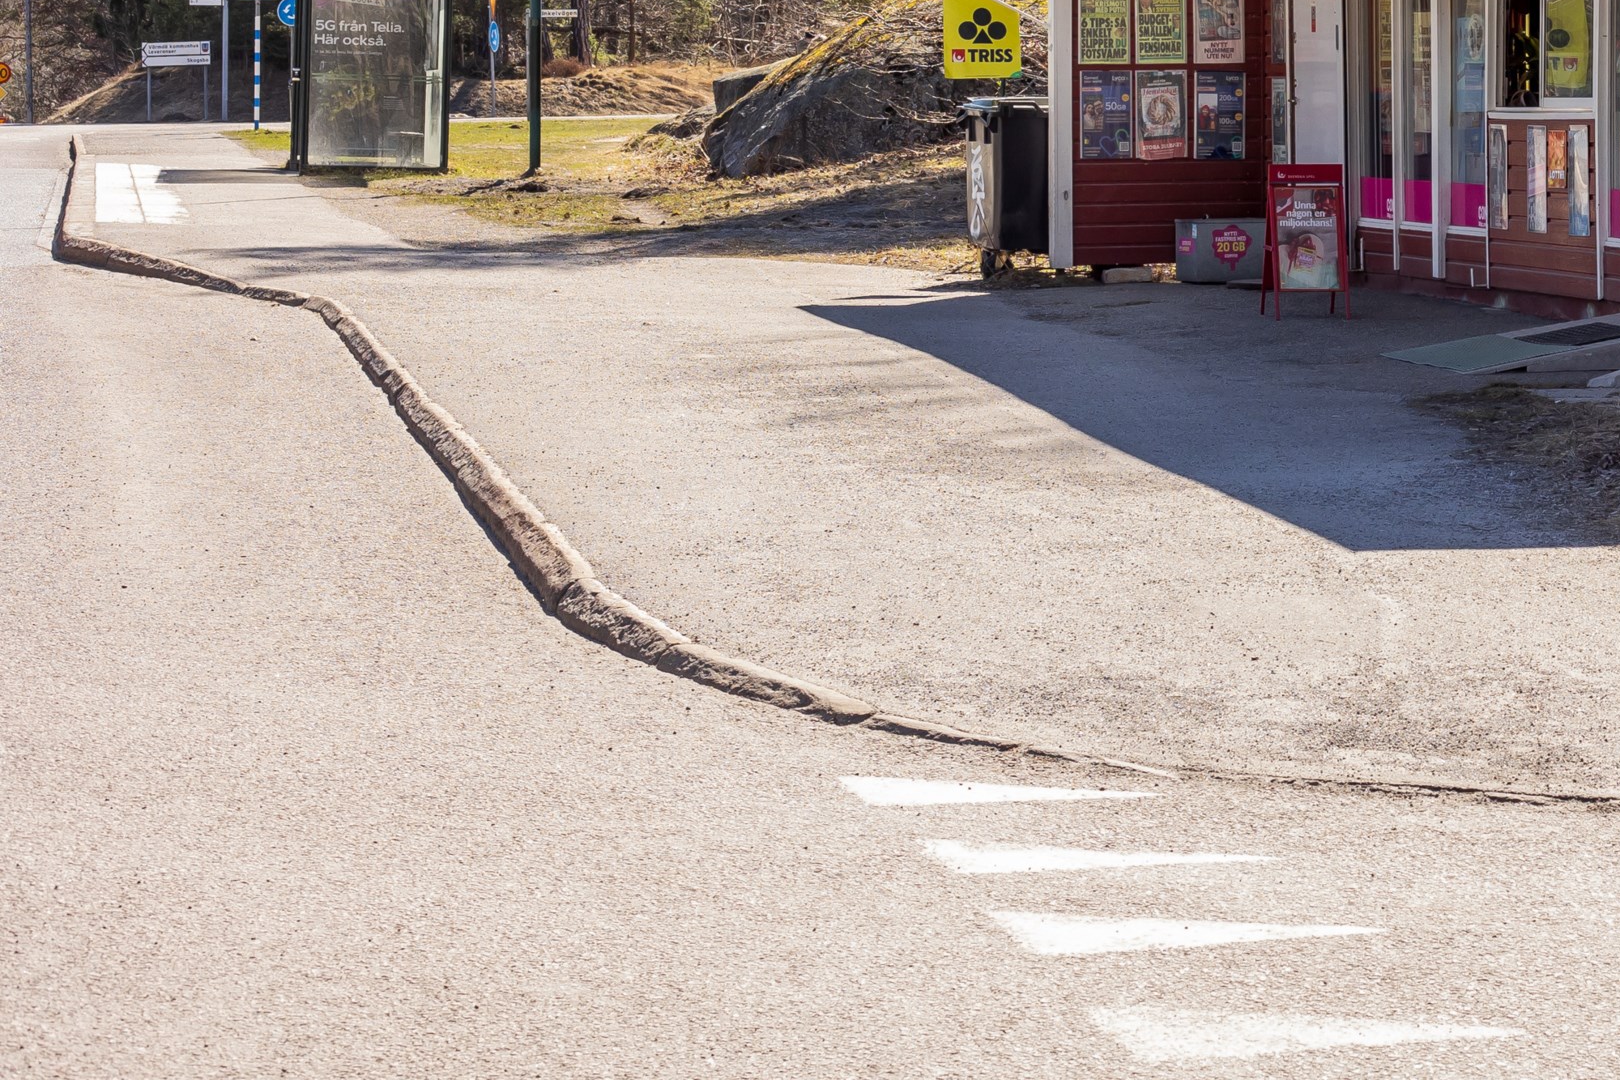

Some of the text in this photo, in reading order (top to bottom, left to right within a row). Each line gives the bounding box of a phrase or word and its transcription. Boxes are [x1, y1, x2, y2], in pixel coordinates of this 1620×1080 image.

[1081, 16, 1126, 28] 6 TIPS: SÅ
[1139, 14, 1172, 25] BUDGET-
[315, 19, 405, 33] 5G från Telia.
[1139, 25, 1172, 37] SMÄLLEN
[1081, 28, 1112, 38] ENKELT
[314, 33, 387, 47] Här också.
[1081, 38, 1126, 48] SLIPPER DU
[1139, 41, 1182, 53] PENSIONÄR
[967, 49, 1013, 63] TRISS
[1081, 48, 1127, 59] FOTSVAMP
[1105, 102, 1126, 110] 50GB
[1294, 201, 1316, 210] Unna
[1286, 210, 1312, 219] någon
[1280, 219, 1332, 228] miljonchans!
[1216, 242, 1246, 252] 20 GB
